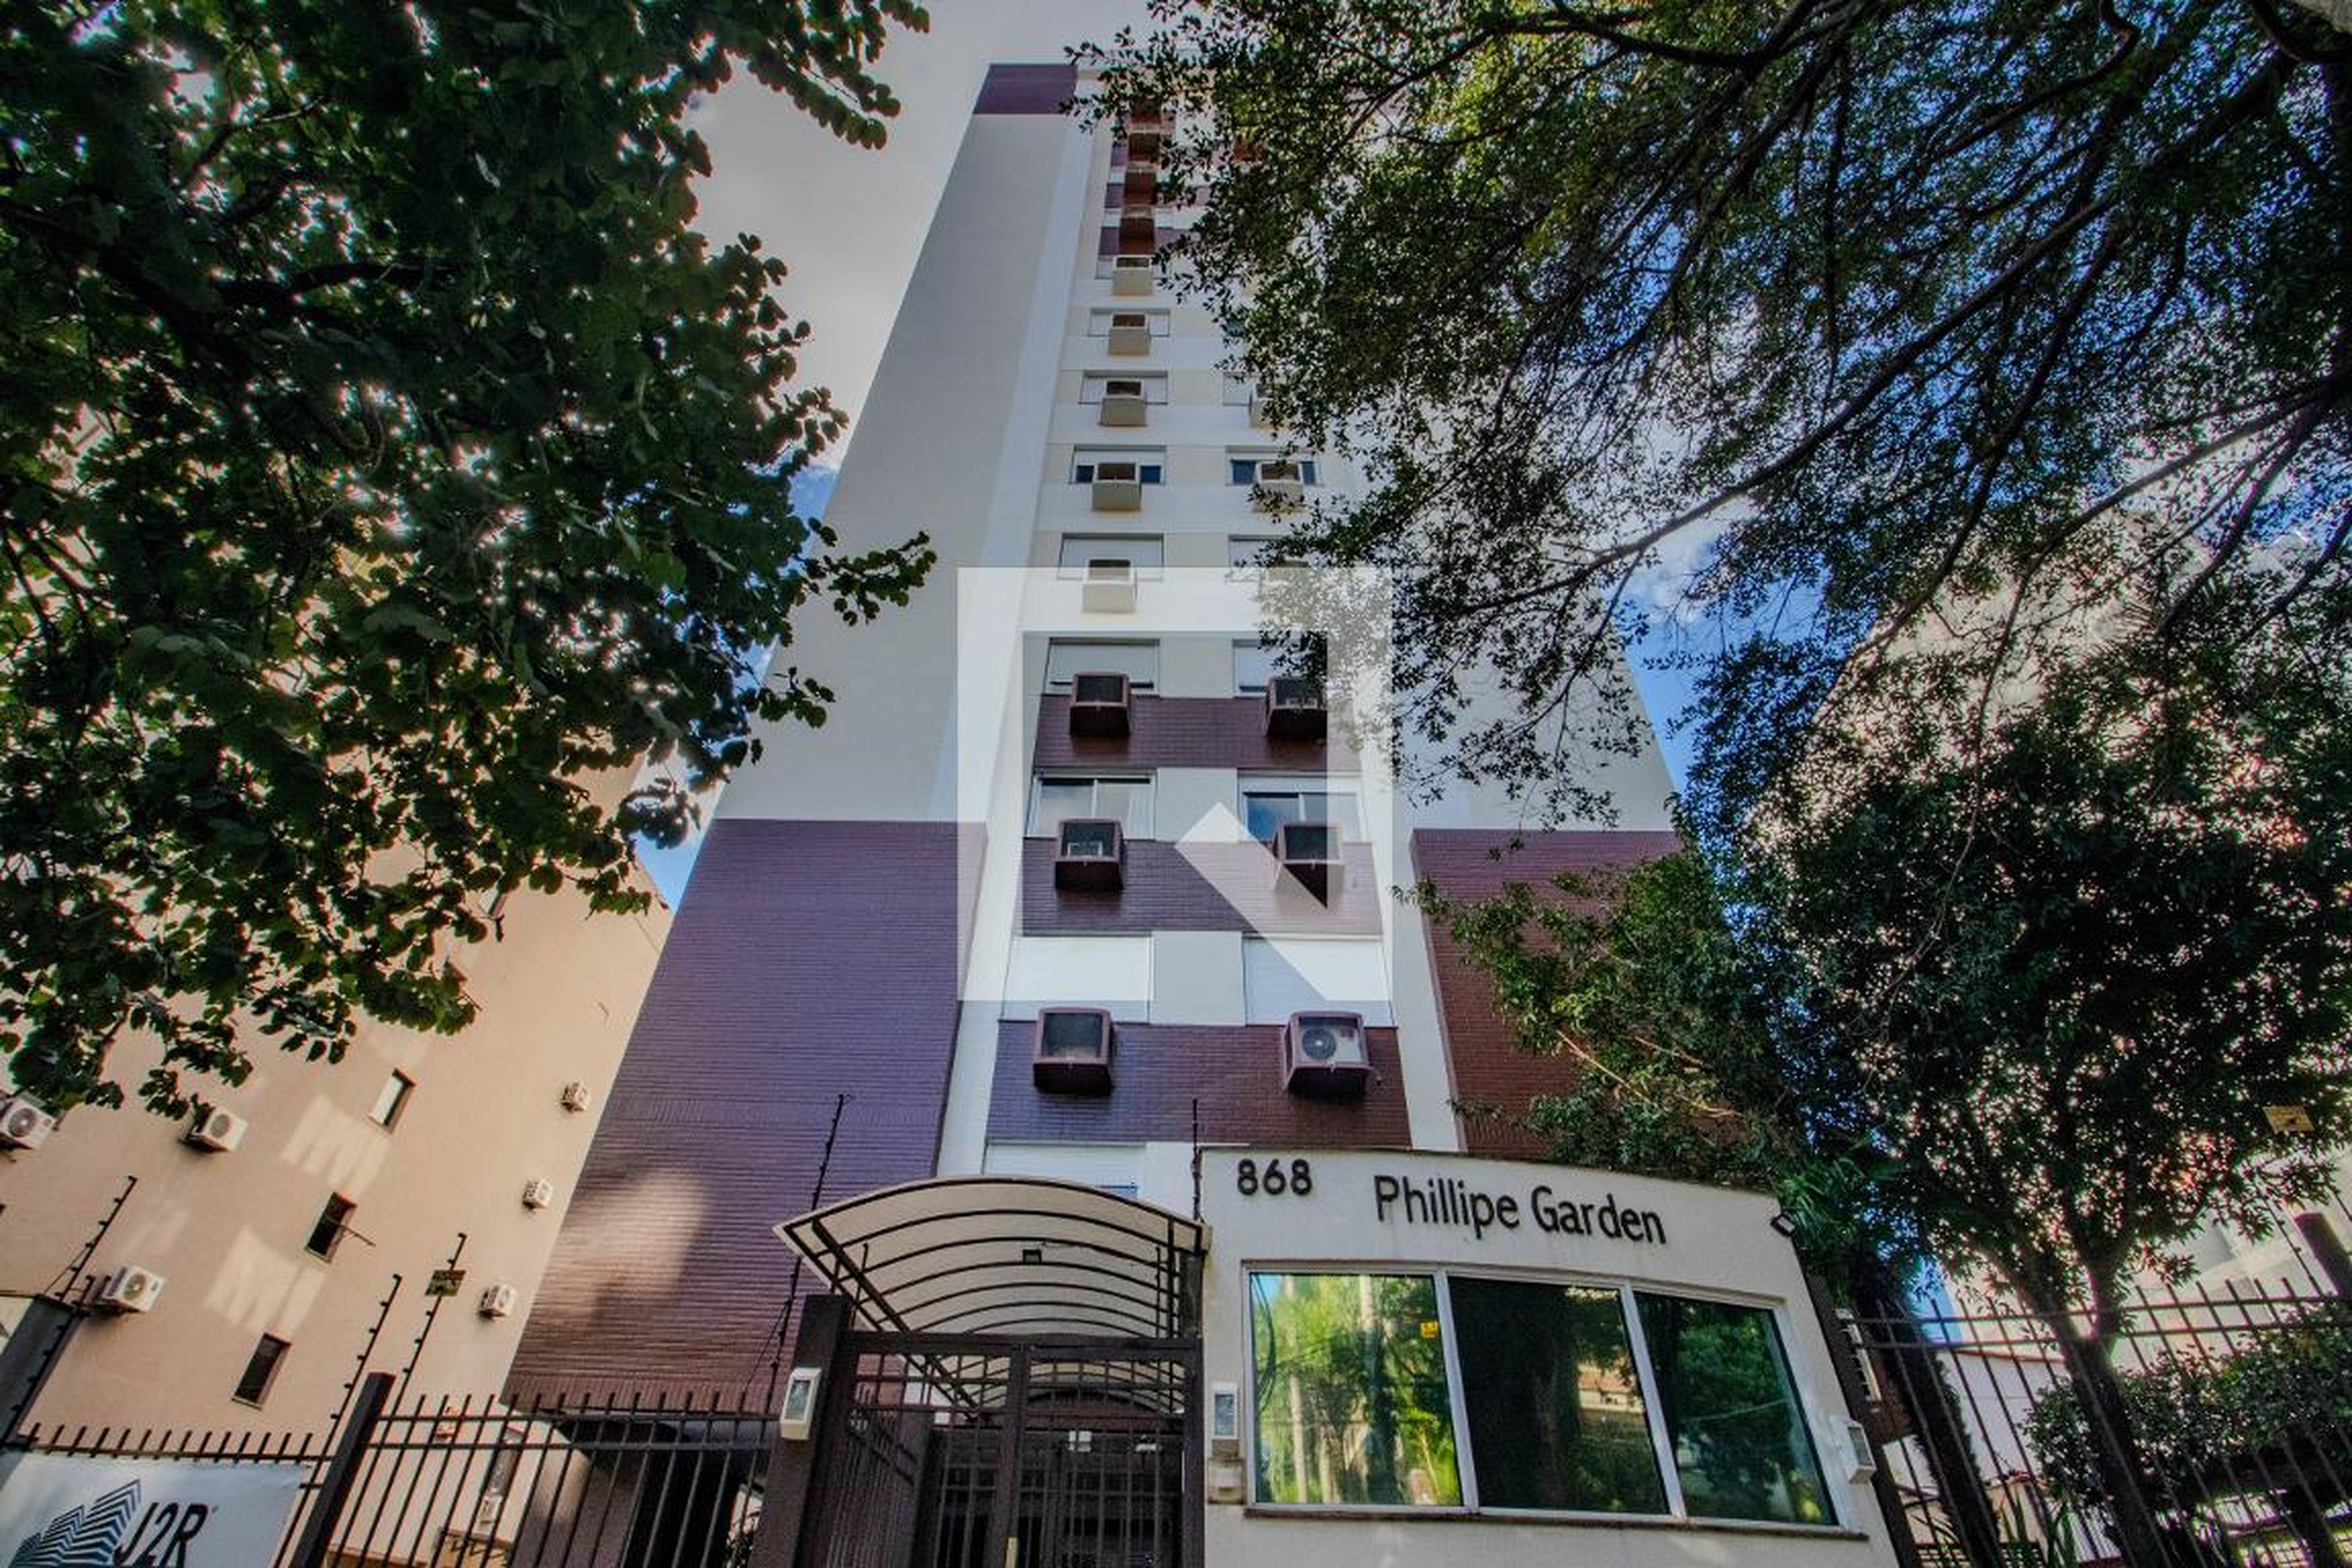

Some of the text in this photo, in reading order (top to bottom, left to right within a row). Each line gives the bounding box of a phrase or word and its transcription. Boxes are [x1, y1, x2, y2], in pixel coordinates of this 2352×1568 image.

[1238, 1158, 1313, 1196] 868
[1374, 1175, 1667, 1244] Phillipe Garden
[113, 1502, 209, 1567] J2R
